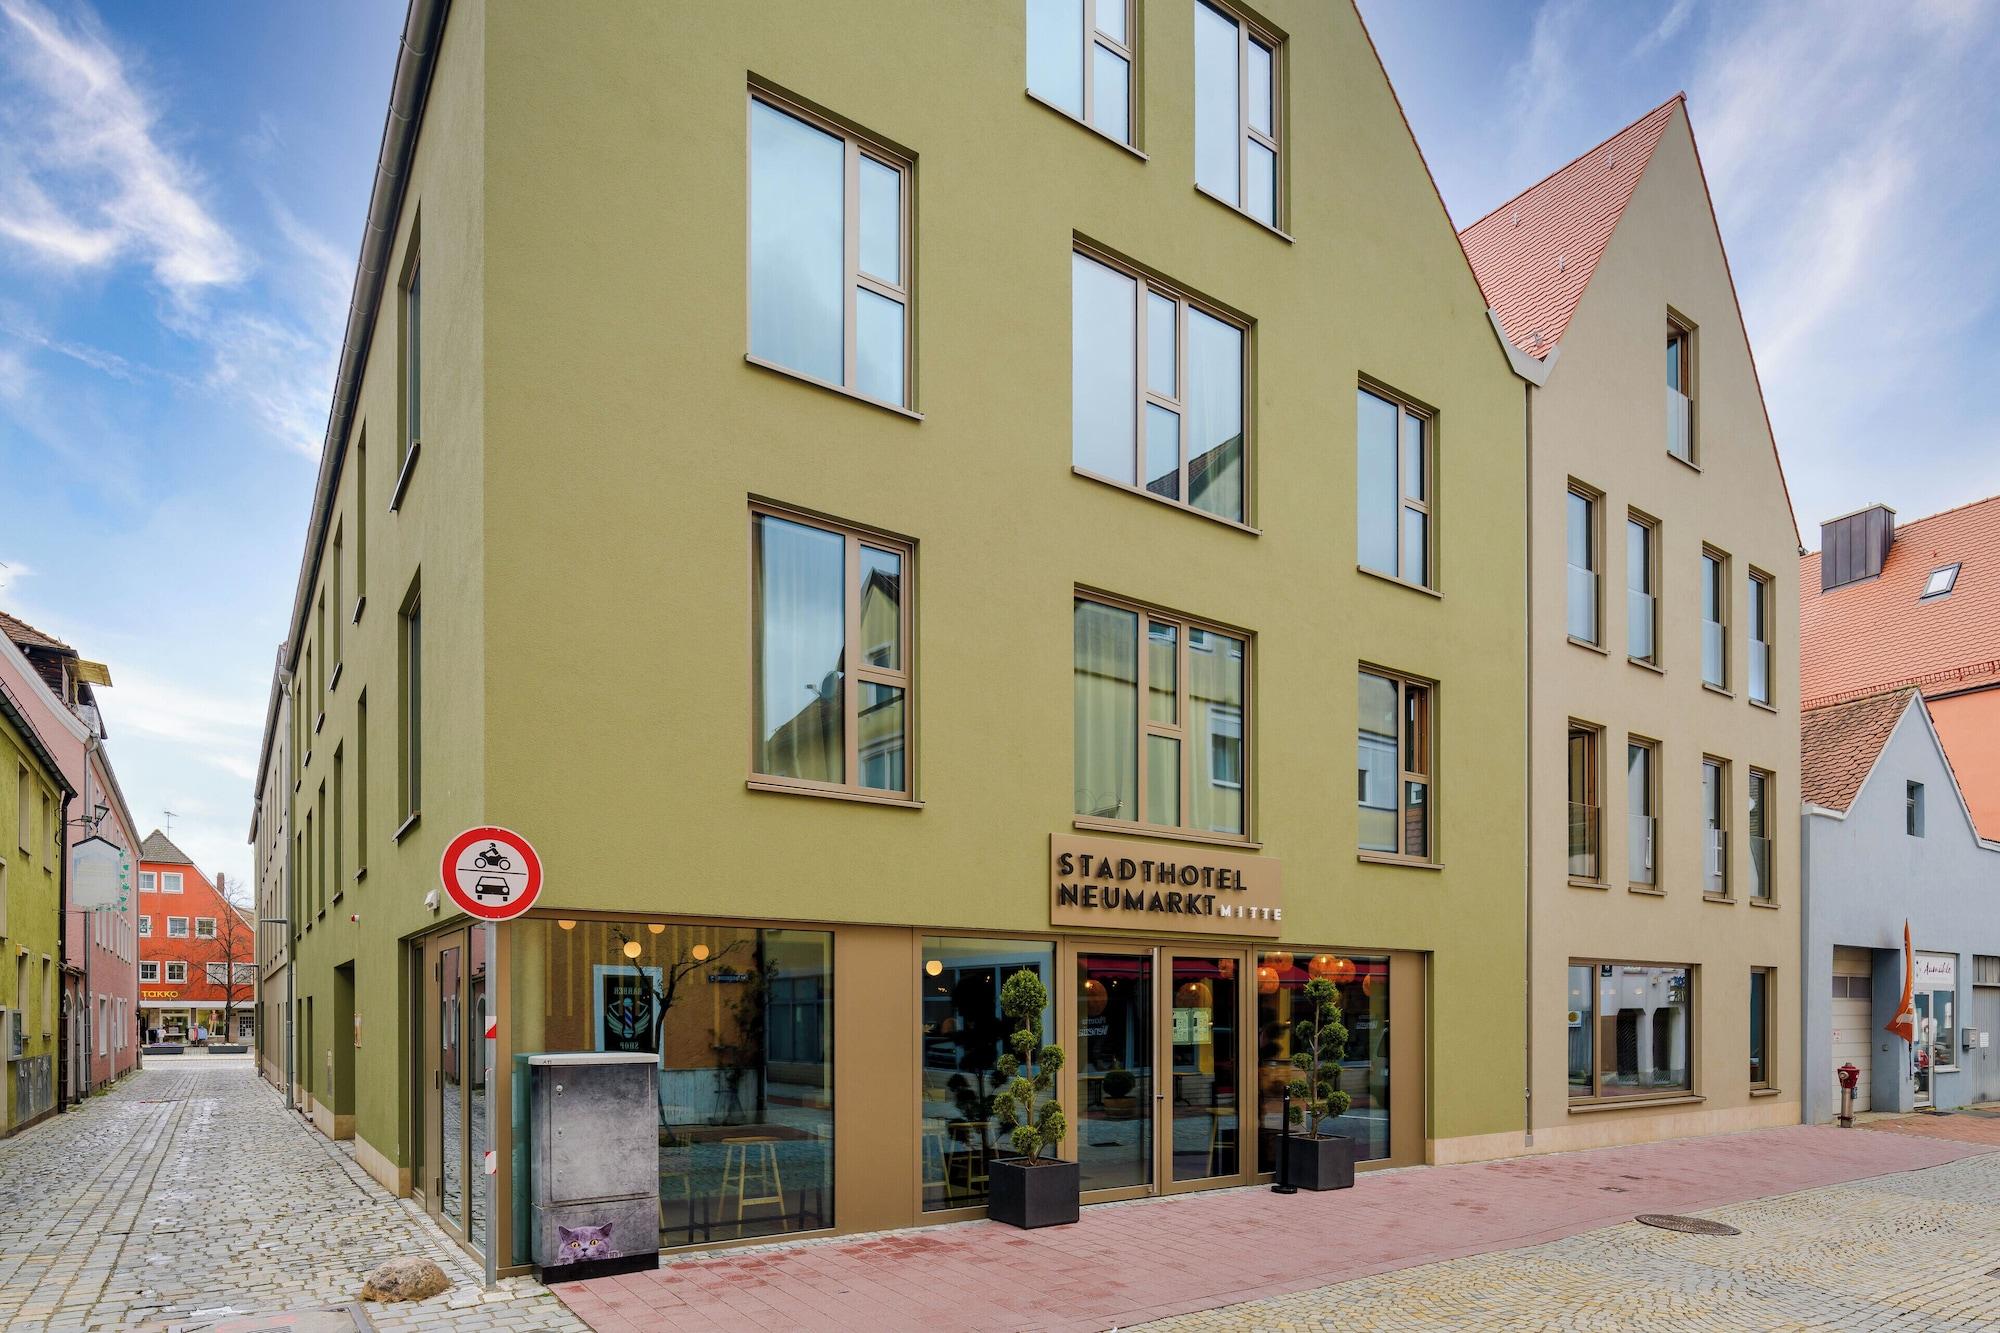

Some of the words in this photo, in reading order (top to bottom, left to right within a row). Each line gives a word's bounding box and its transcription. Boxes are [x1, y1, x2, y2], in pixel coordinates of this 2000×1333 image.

[1059, 852, 1247, 891] STADTHOTEL
[1060, 883, 1216, 915] NEUMARKT
[1220, 904, 1282, 921] MITTE
